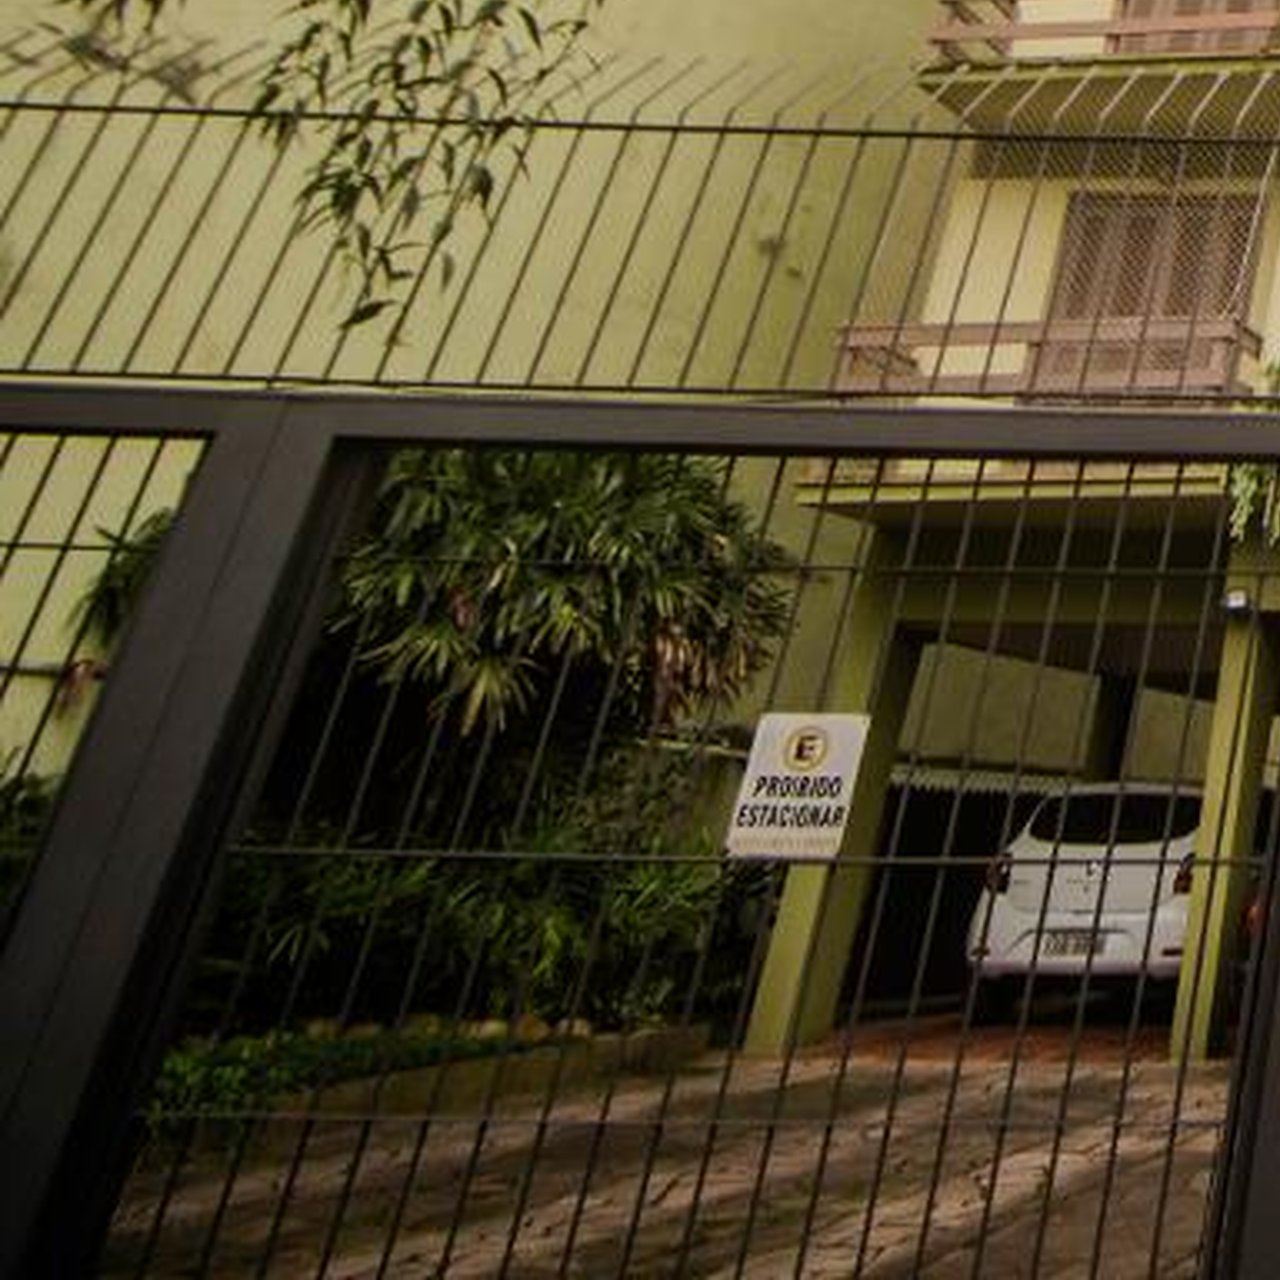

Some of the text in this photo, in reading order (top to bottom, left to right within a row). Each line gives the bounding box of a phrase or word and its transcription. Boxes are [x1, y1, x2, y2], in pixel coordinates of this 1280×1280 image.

[795, 734, 819, 761] E
[752, 775, 843, 798] PROIBIDO
[736, 803, 847, 828] ESTACIONAR
